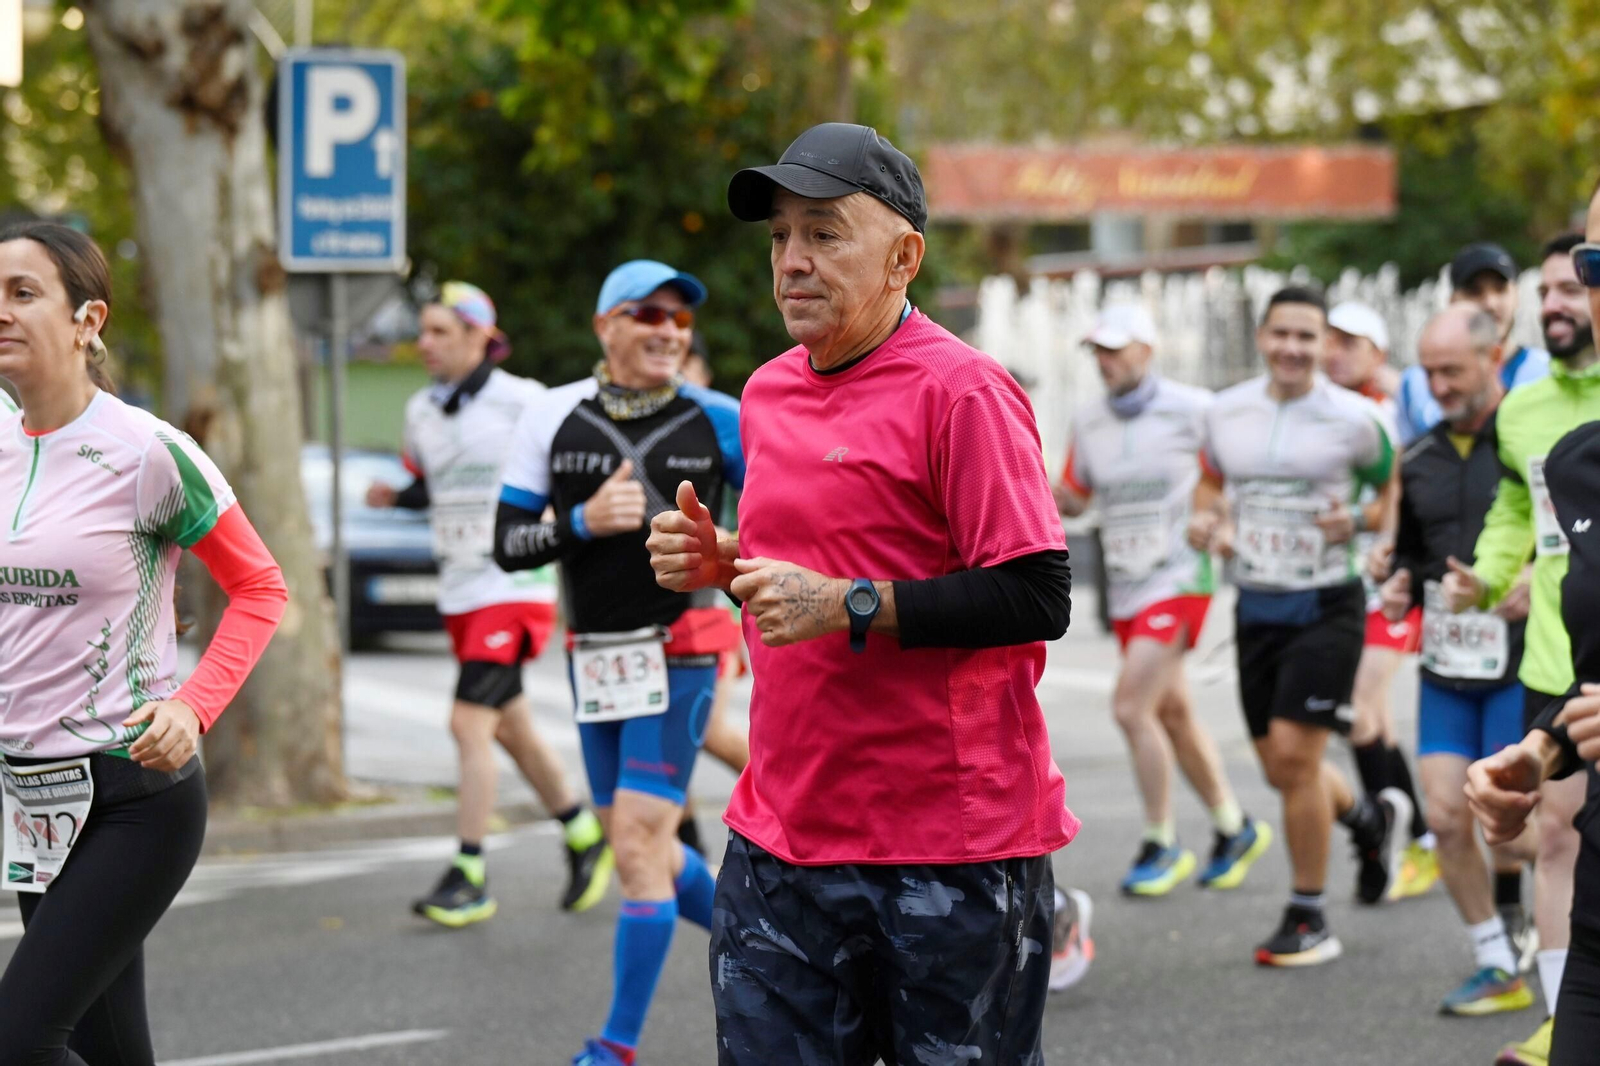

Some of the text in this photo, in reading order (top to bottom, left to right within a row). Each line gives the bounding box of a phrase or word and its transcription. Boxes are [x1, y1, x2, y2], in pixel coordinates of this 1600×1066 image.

[303, 65, 381, 178] P
[77, 444, 103, 463] SIG
[11, 592, 79, 608] ERMITAS
[593, 650, 651, 686] 213
[23, 775, 42, 787] LAS
[40, 768, 83, 786] ERMITAS
[40, 787, 53, 800] DE
